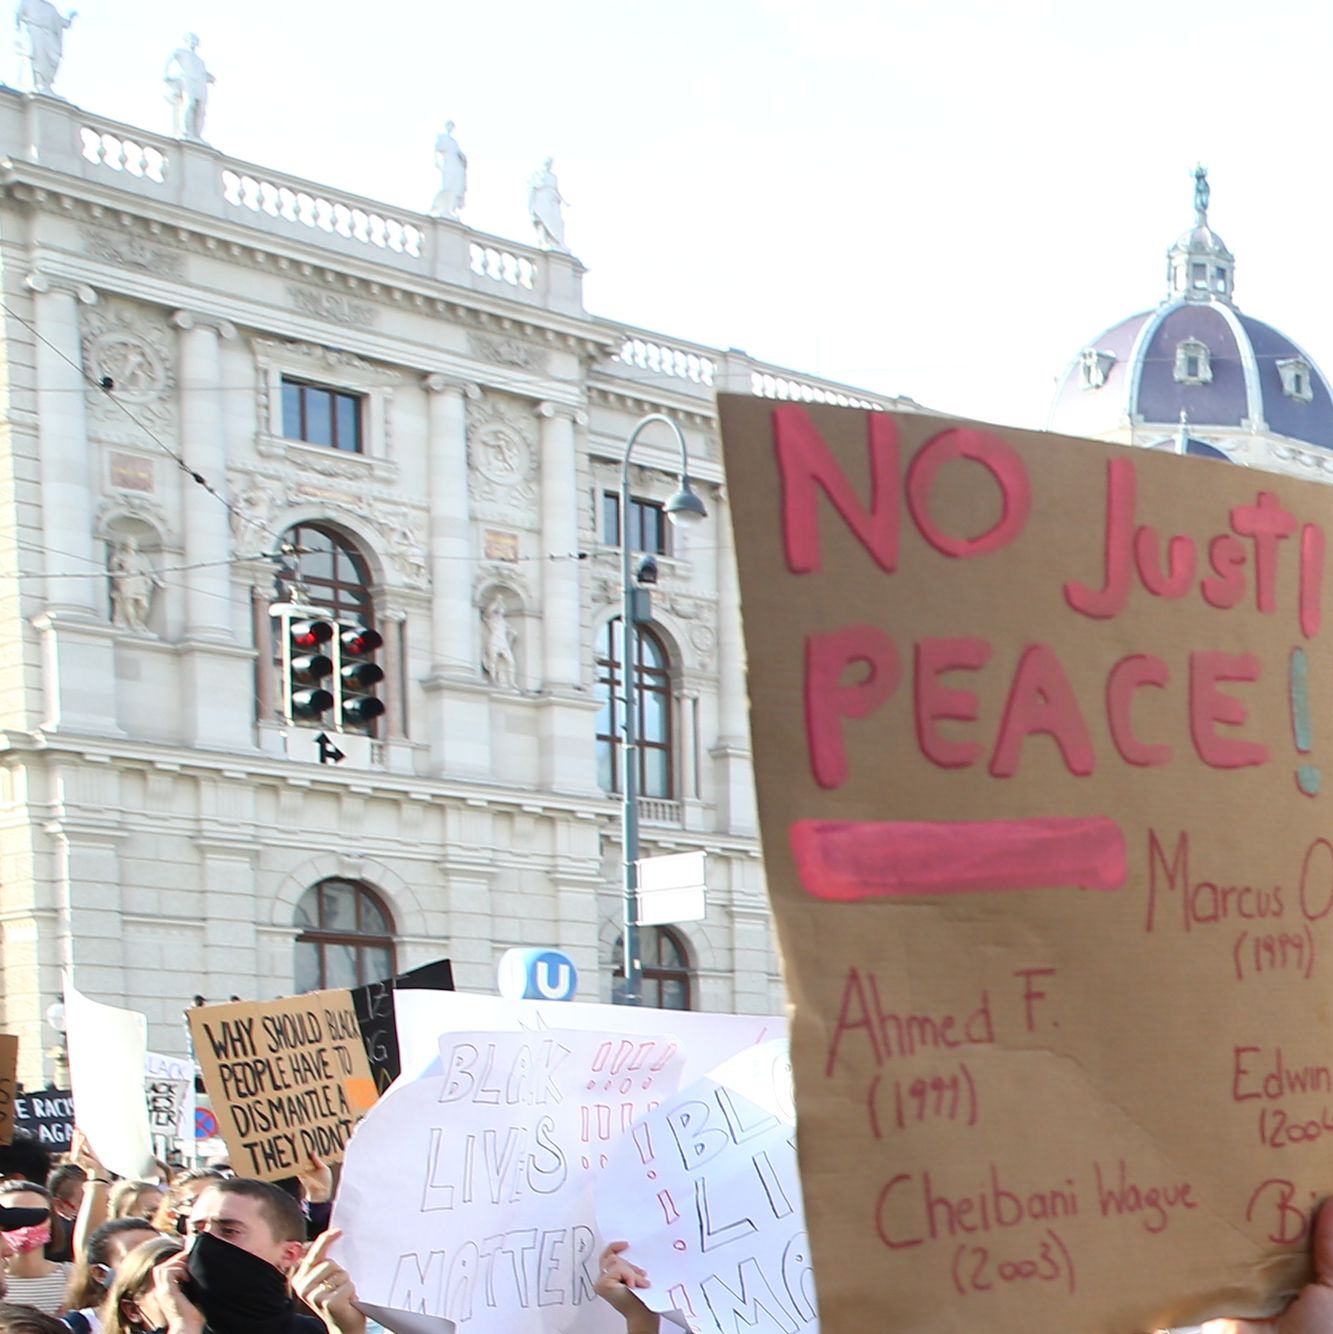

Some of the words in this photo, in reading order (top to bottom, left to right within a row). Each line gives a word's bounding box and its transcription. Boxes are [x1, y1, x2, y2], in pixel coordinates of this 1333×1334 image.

[772, 405, 1031, 574] NO
[804, 624, 1323, 797] PEACE!
[1145, 828, 1283, 933] Marcus
[536, 957, 569, 993] U
[203, 1017, 257, 1060] WHY
[262, 1011, 323, 1053] SHOULD
[825, 966, 994, 1077] Ahmed
[1015, 967, 1060, 1034] F.
[218, 1057, 290, 1101] PEOPLE
[291, 1048, 334, 1081] HAVE
[333, 1046, 353, 1076] TO
[1233, 1045, 1331, 1101] Edwin
[231, 1086, 337, 1138] DISMANTLE
[336, 1083, 350, 1114] A
[243, 1133, 299, 1175] THEY
[874, 1165, 1078, 1250] Cheibani
[386, 1225, 600, 1322] MATTER
[951, 1230, 1076, 1294] (2003)
